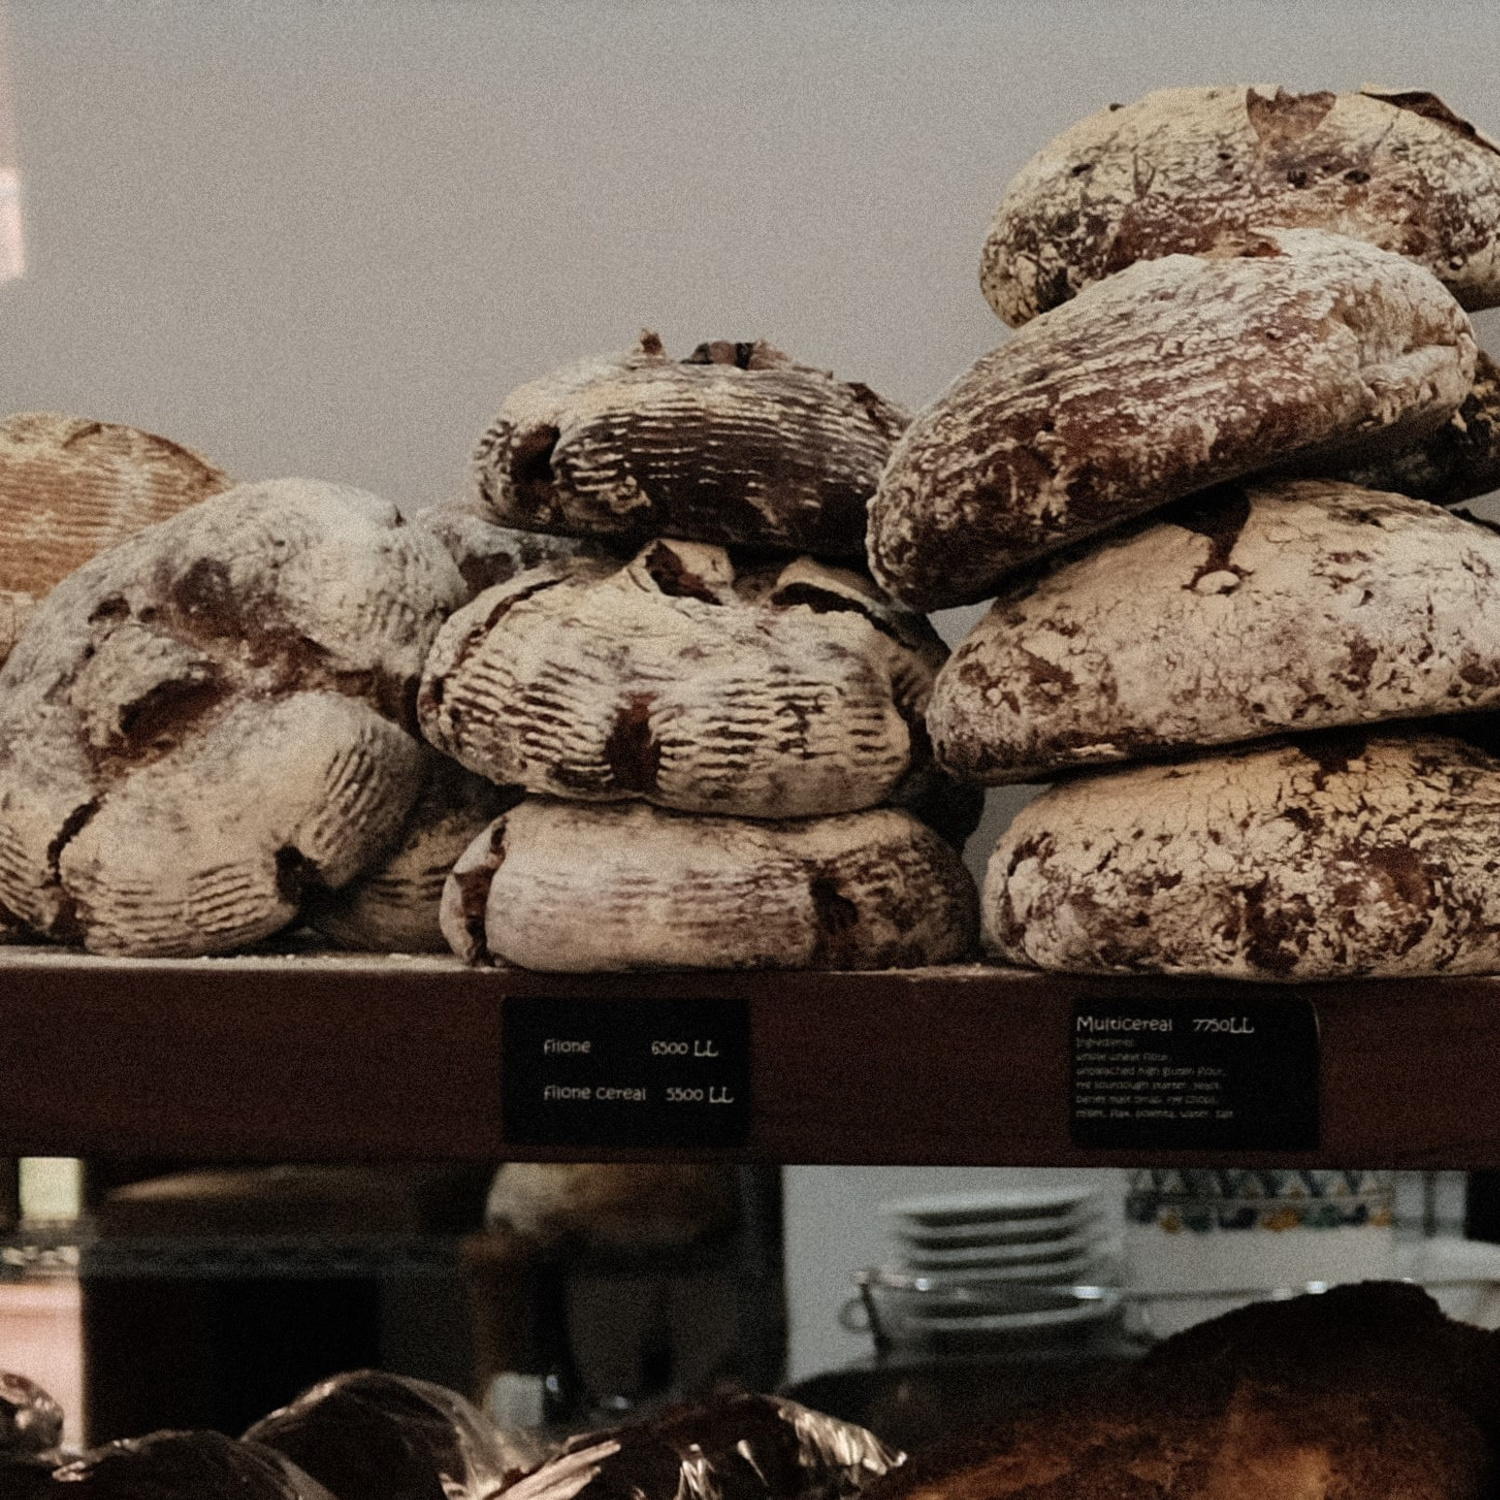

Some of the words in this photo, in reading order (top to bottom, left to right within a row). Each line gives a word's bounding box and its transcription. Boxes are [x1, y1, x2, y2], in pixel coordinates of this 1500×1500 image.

[1076, 1015, 1173, 1033] Multicereal
[651, 1040, 689, 1056] 6500
[693, 1039, 719, 1058] LL
[595, 1086, 646, 1102] Cereal
[665, 1087, 705, 1102] 5500
[708, 1086, 735, 1104] LL
